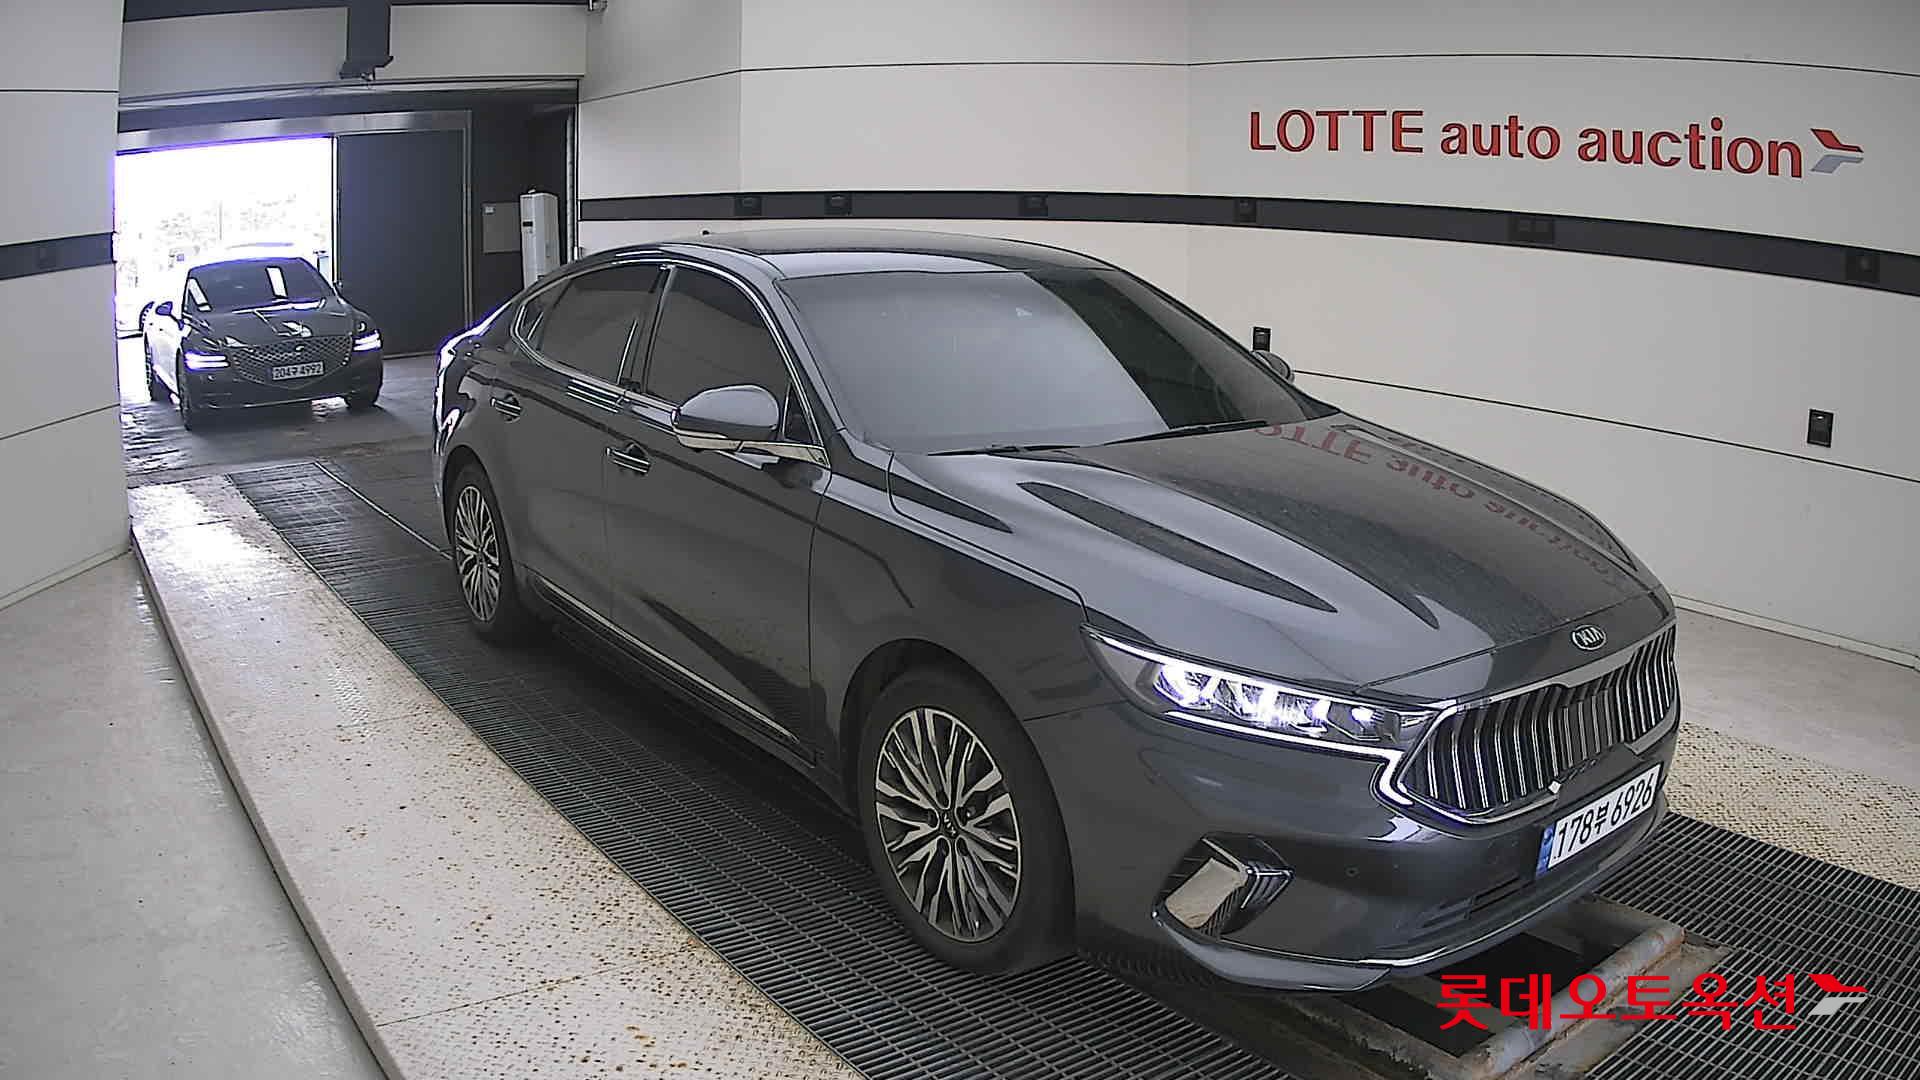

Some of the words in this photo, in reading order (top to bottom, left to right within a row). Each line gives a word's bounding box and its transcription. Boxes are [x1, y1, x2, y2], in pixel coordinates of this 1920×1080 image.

[1248, 110, 1425, 154] LOTTE
[1440, 115, 1563, 160] auto
[1576, 117, 1803, 178] auction
[1576, 627, 1604, 646] KIA
[1557, 801, 1609, 858] 178부
[1610, 772, 1655, 827] 6926
